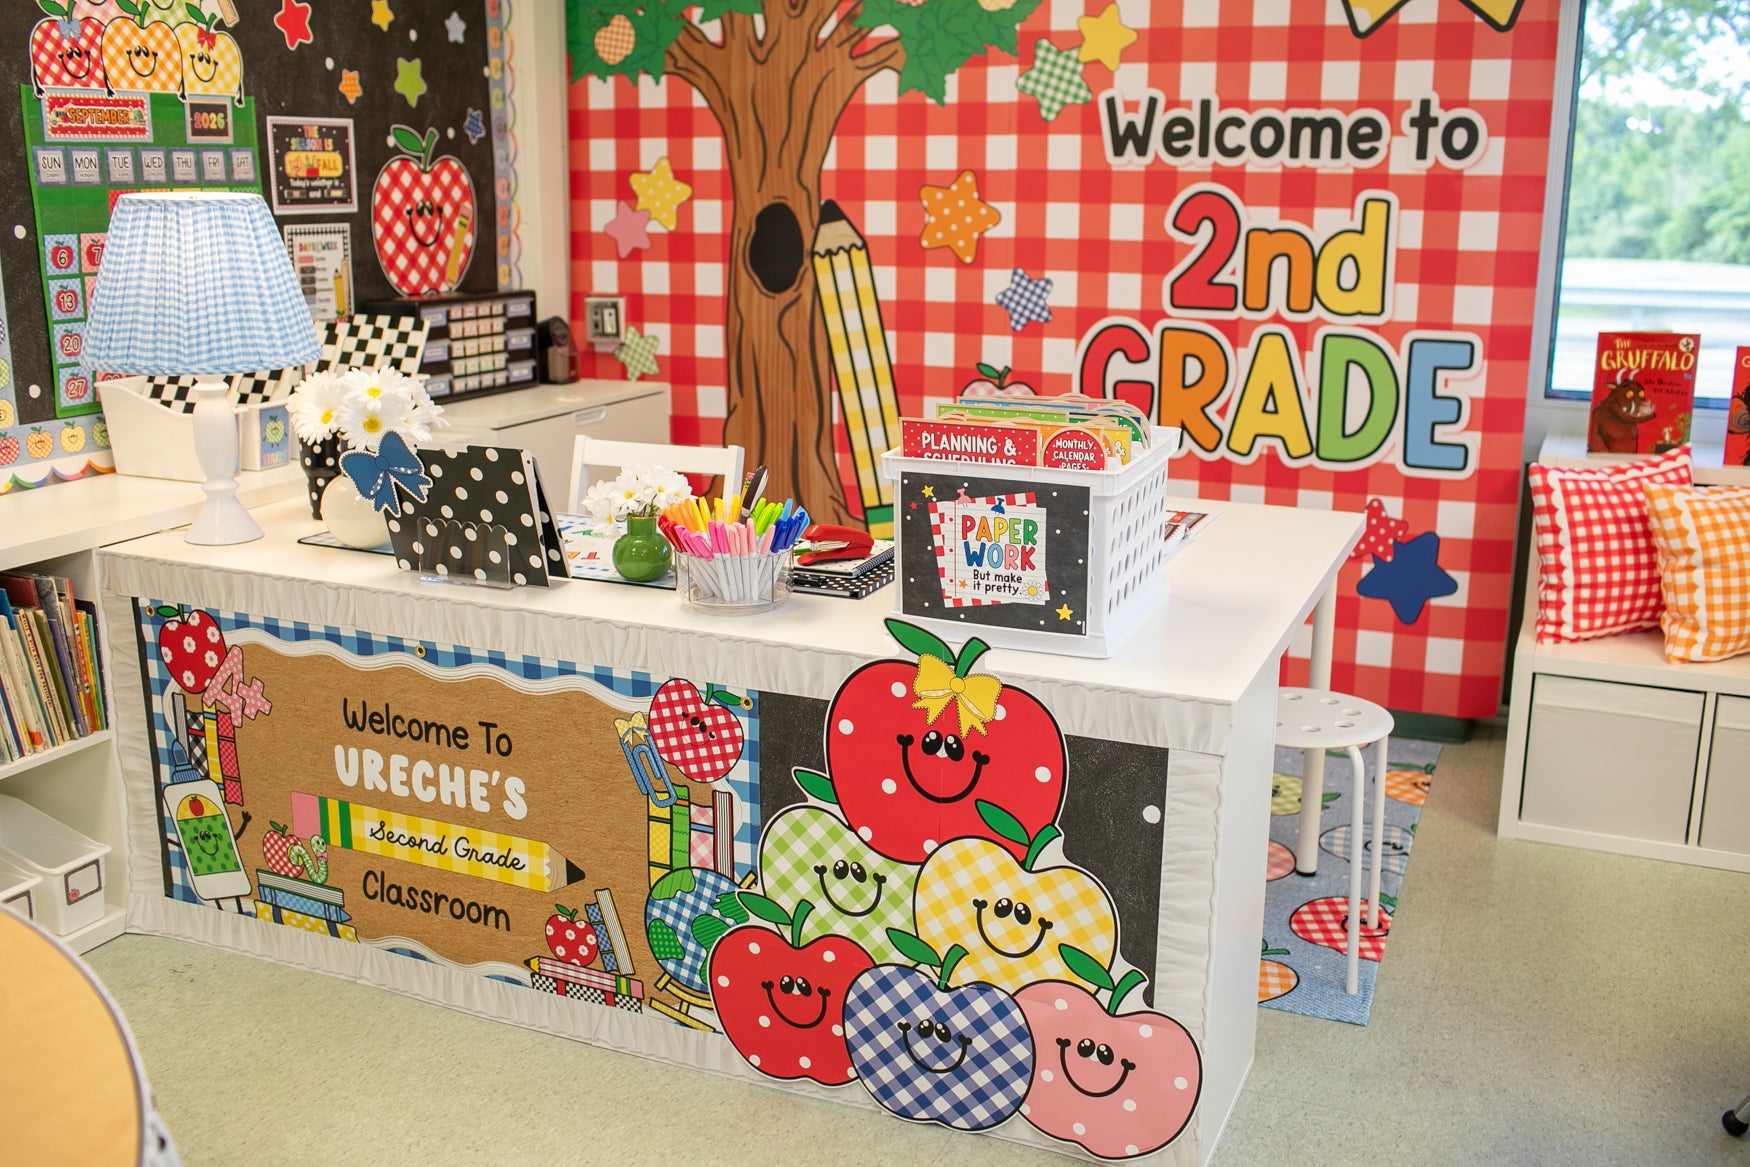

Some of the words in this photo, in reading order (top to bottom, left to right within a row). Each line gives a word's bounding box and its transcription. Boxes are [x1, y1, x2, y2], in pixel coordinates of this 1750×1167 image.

[68, 107, 130, 125] SEPTEMBER
[193, 112, 225, 129] 2026
[1105, 96, 1383, 159] Welcome
[1409, 98, 1480, 160] to
[41, 156, 62, 169] SUN
[74, 156, 97, 169] MON
[112, 156, 130, 169] TUE
[143, 156, 163, 169] WED
[176, 156, 192, 169] THU
[207, 156, 220, 168] FRI
[236, 156, 249, 168] SAT
[316, 157, 339, 171] FALL
[58, 250, 67, 265] 6
[93, 248, 100, 263] 7
[1170, 190, 1391, 316] 2nd
[60, 294, 74, 309] 13
[63, 338, 80, 352] 20
[1614, 338, 1632, 349] THE
[1601, 349, 1695, 371] GRUFFALO
[69, 380, 84, 396] 27
[1079, 323, 1475, 471] GRADE
[921, 432, 998, 455] PLANNING
[1003, 438, 1017, 456] &
[1055, 439, 1094, 450] MONTHLY
[1053, 450, 1095, 462] CALENDAR
[1061, 462, 1087, 471] PAGES
[961, 514, 1039, 546] PAPER
[963, 541, 1036, 571] WORK
[973, 569, 991, 580] But
[994, 572, 1023, 584] make
[973, 580, 982, 591] it
[984, 582, 1022, 596] pretty.
[342, 697, 469, 750] Welcome
[478, 720, 513, 758] To
[334, 744, 528, 820] URECHE'S
[369, 821, 448, 856] Second
[454, 836, 526, 871] Grade
[362, 869, 511, 932] Classroom
